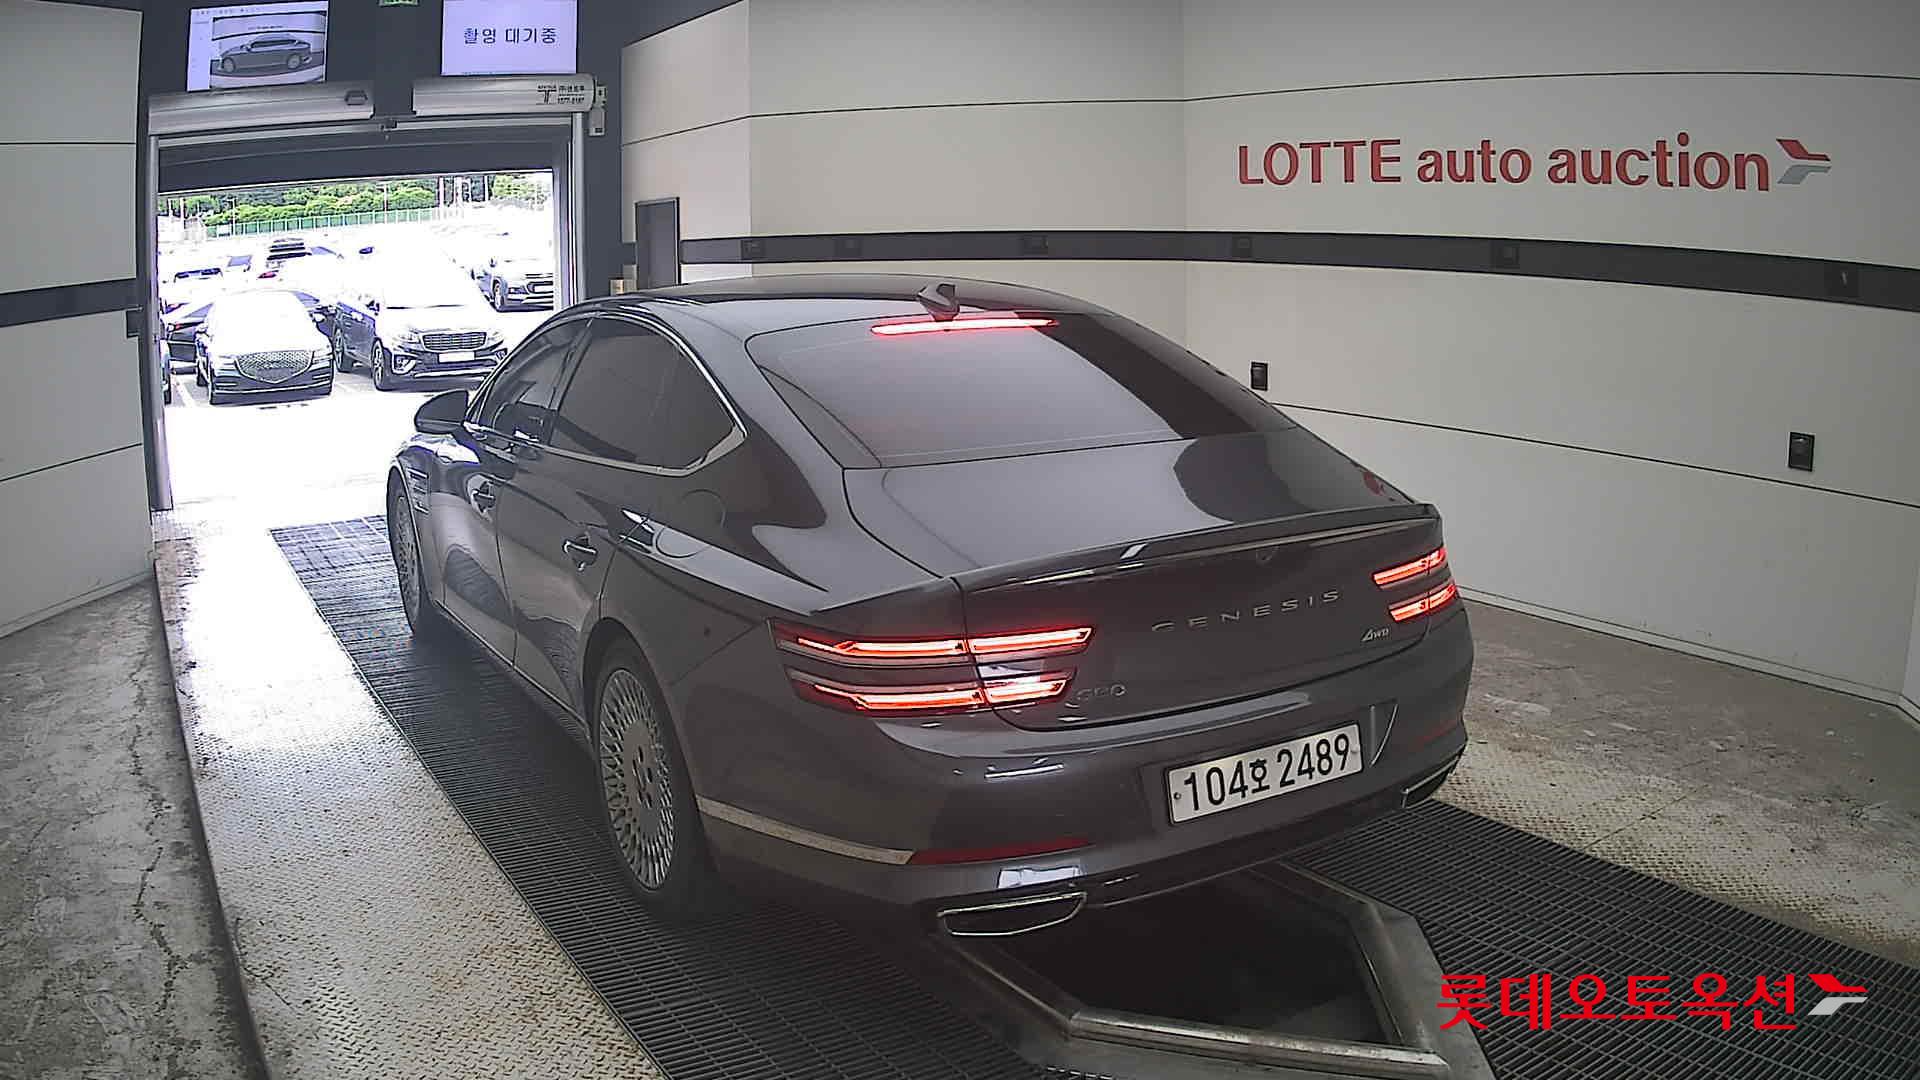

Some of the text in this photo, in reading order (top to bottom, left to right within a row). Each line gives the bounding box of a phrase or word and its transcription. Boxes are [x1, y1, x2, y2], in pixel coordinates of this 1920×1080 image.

[505, 27, 557, 44] 대기중
[1239, 132, 1770, 192] LOTTE auto auction
[1151, 590, 1340, 632] GENESIS
